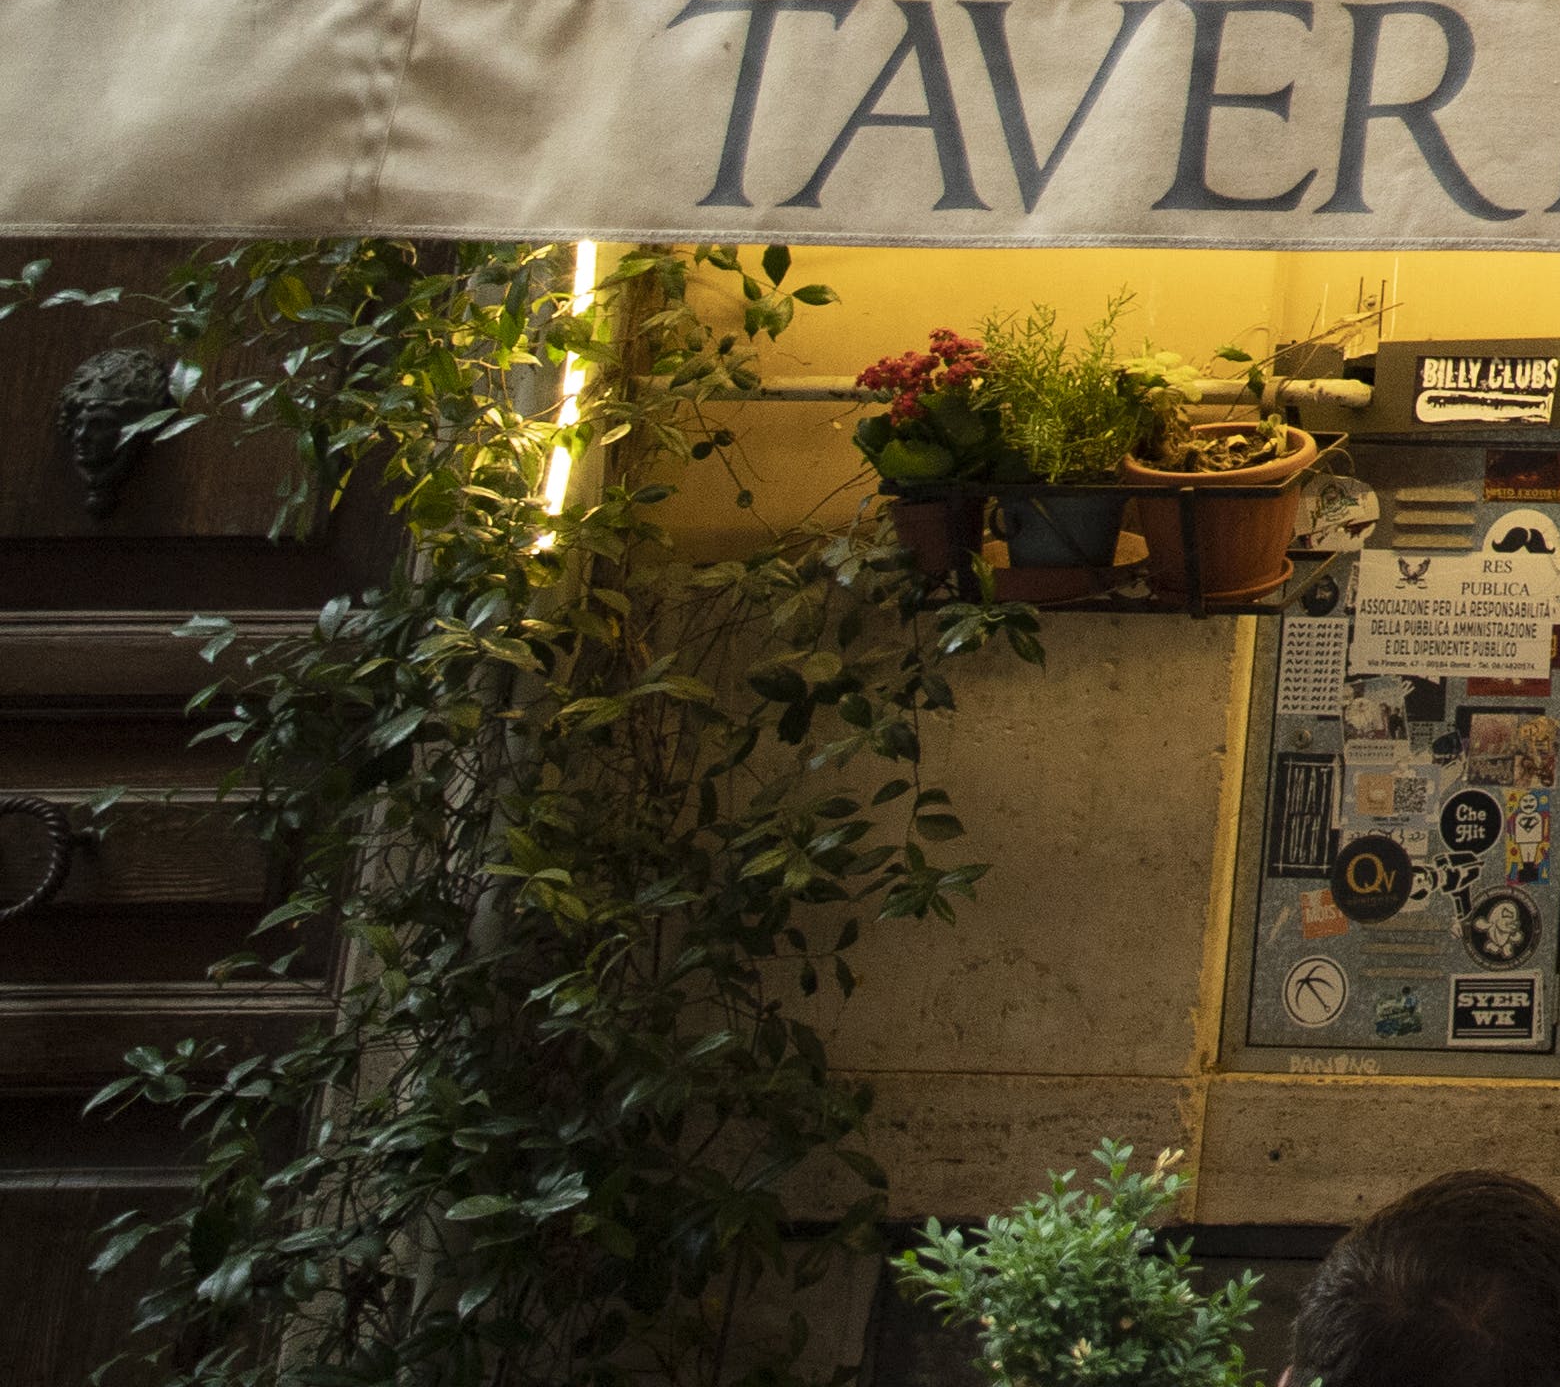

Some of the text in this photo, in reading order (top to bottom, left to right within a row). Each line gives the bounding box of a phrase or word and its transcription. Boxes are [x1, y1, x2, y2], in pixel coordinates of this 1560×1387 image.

[1422, 357, 1559, 389] BILLY CLUBS
[1483, 559, 1513, 574] RES
[1461, 582, 1531, 597] PUBLICA
[1360, 599, 1430, 616] ASSOCIAZIONE
[1433, 601, 1452, 617] PER
[1454, 602, 1468, 617] LA
[1370, 619, 1538, 639] DELLA PUBBLICA AMMINISTRAZIONE
[1385, 640, 1518, 658] E DEL DIPENDENTE PUBBLICO
[1456, 803, 1487, 822] Che
[1457, 992, 1530, 1008] SYER
[1471, 1010, 1516, 1026] WK
